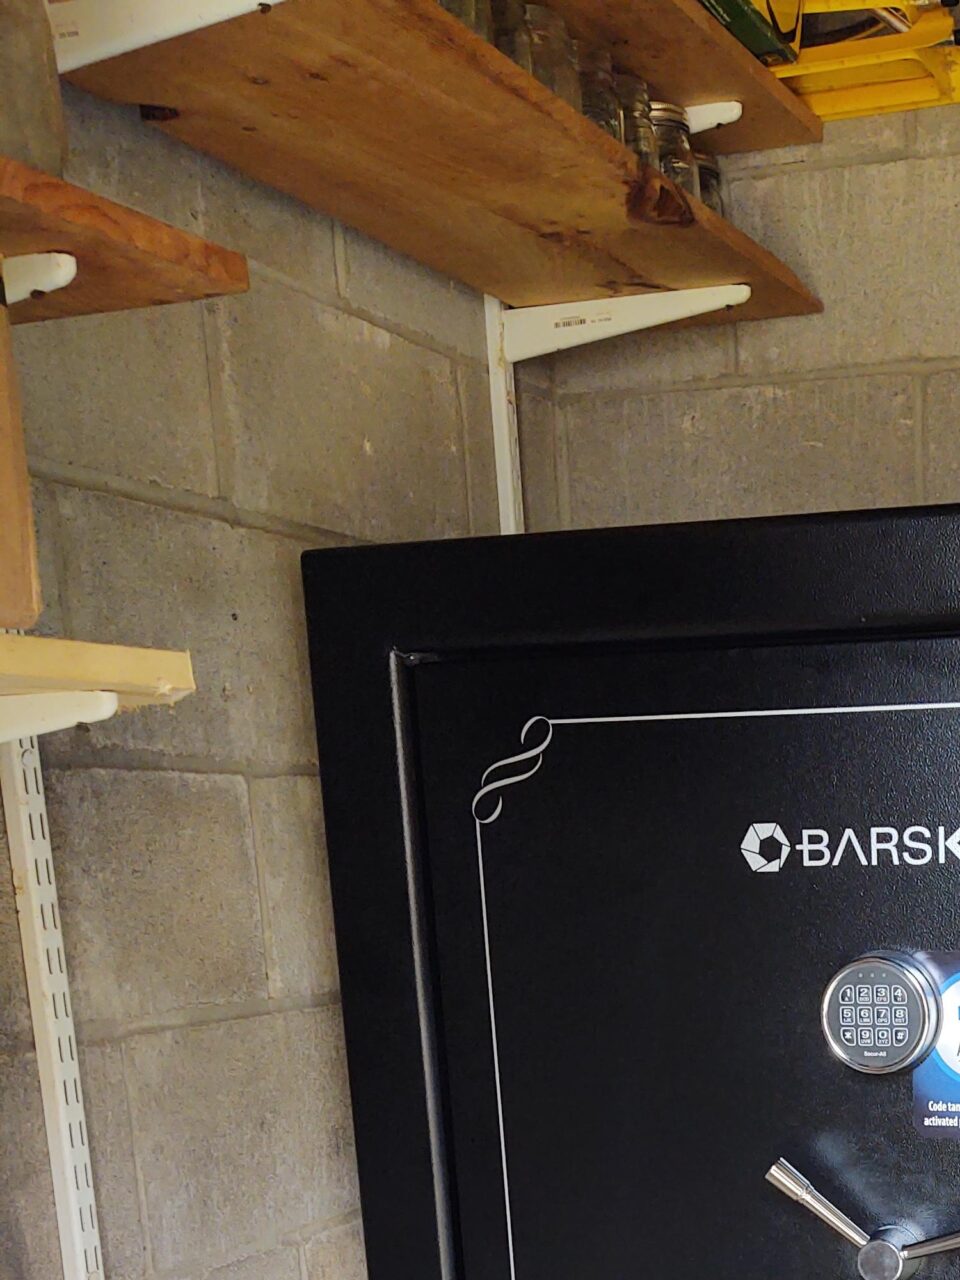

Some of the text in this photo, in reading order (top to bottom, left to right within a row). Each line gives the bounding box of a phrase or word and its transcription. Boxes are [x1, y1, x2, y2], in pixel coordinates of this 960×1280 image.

[845, 988, 851, 997] 1
[859, 988, 869, 997] 2
[877, 988, 886, 997] 3
[894, 988, 902, 997] 4
[843, 1009, 852, 1018] 5
[860, 1009, 869, 1018] 6
[878, 1009, 886, 1018] 7
[895, 1009, 904, 1018] 8
[861, 1030, 870, 1039] 9
[878, 1030, 887, 1039] 0
[928, 1100, 947, 1112] Code
[924, 1115, 958, 1127] activated
